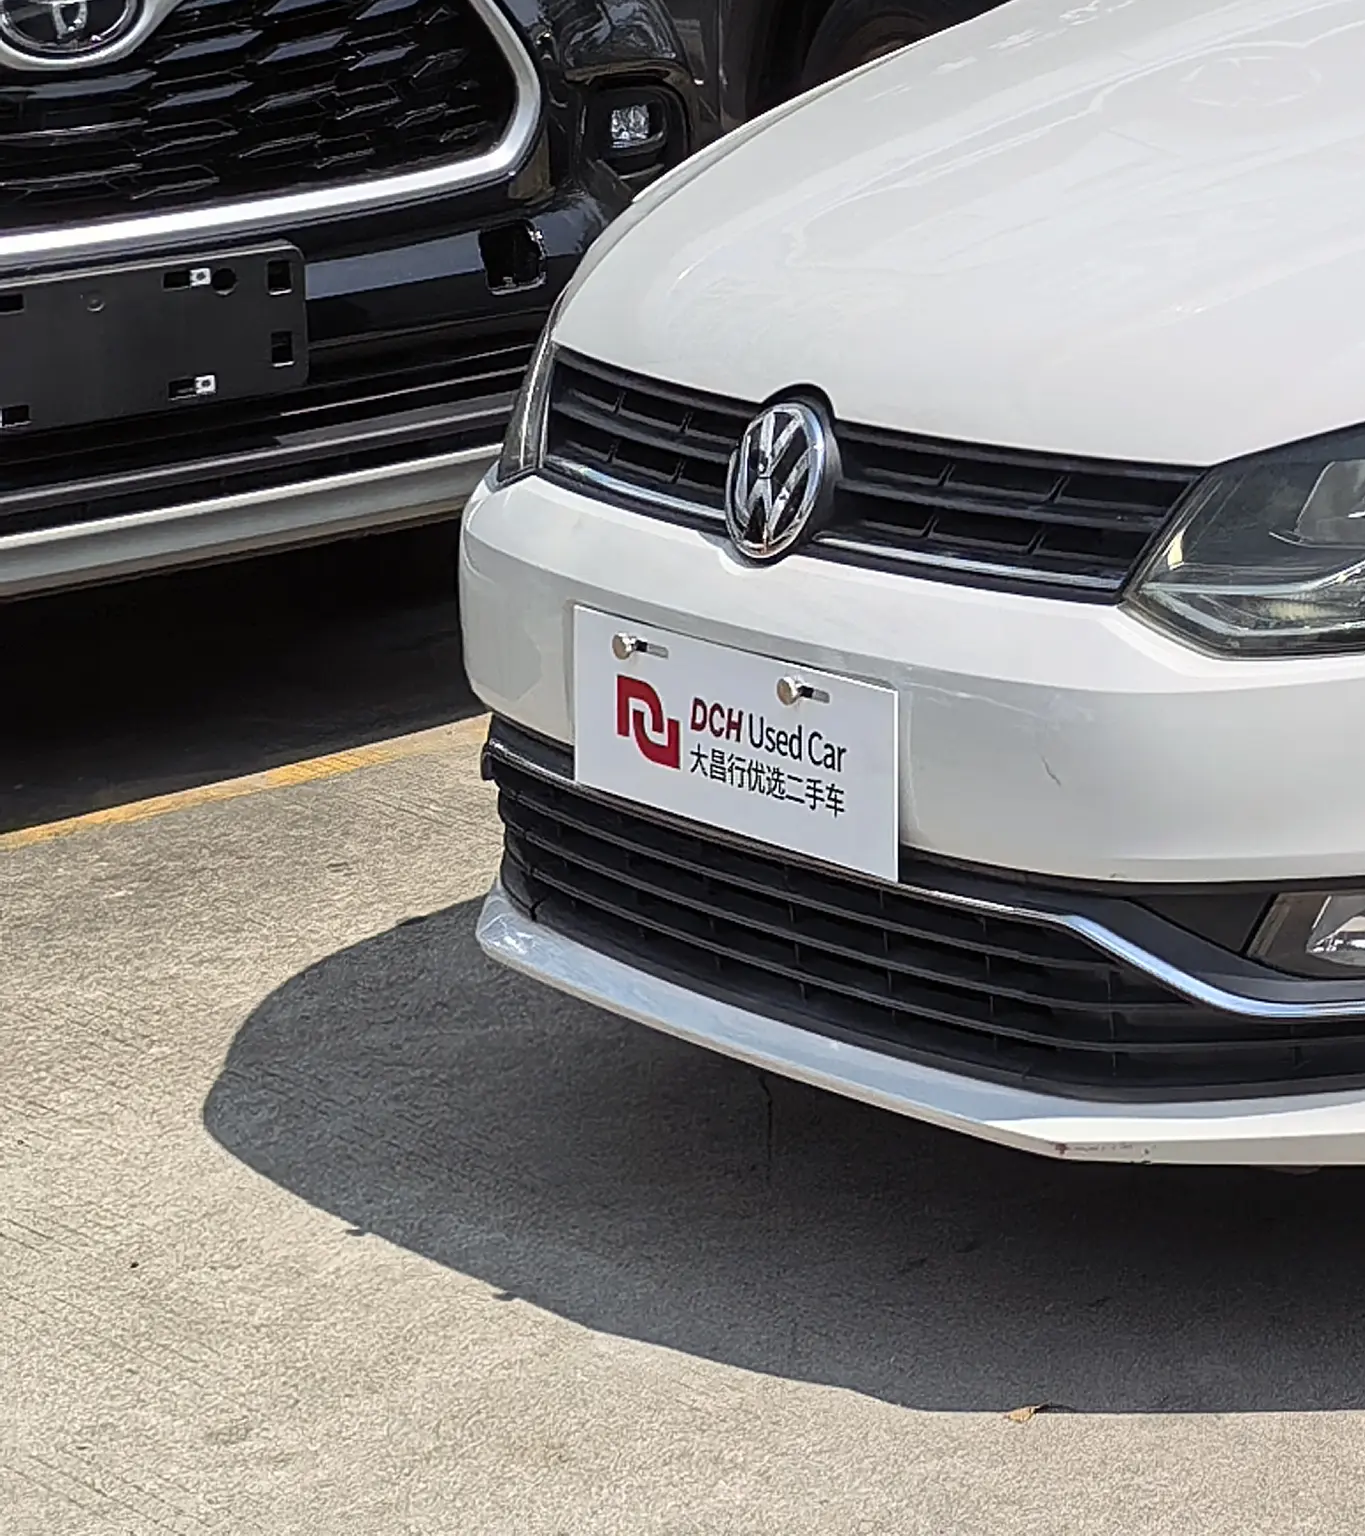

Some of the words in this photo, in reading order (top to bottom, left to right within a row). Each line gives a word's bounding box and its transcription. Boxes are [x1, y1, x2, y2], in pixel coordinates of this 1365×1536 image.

[689, 697, 742, 743] DCH
[748, 714, 802, 762] Used
[807, 731, 847, 773] Car
[689, 743, 845, 818] 大昌行优选二手车
